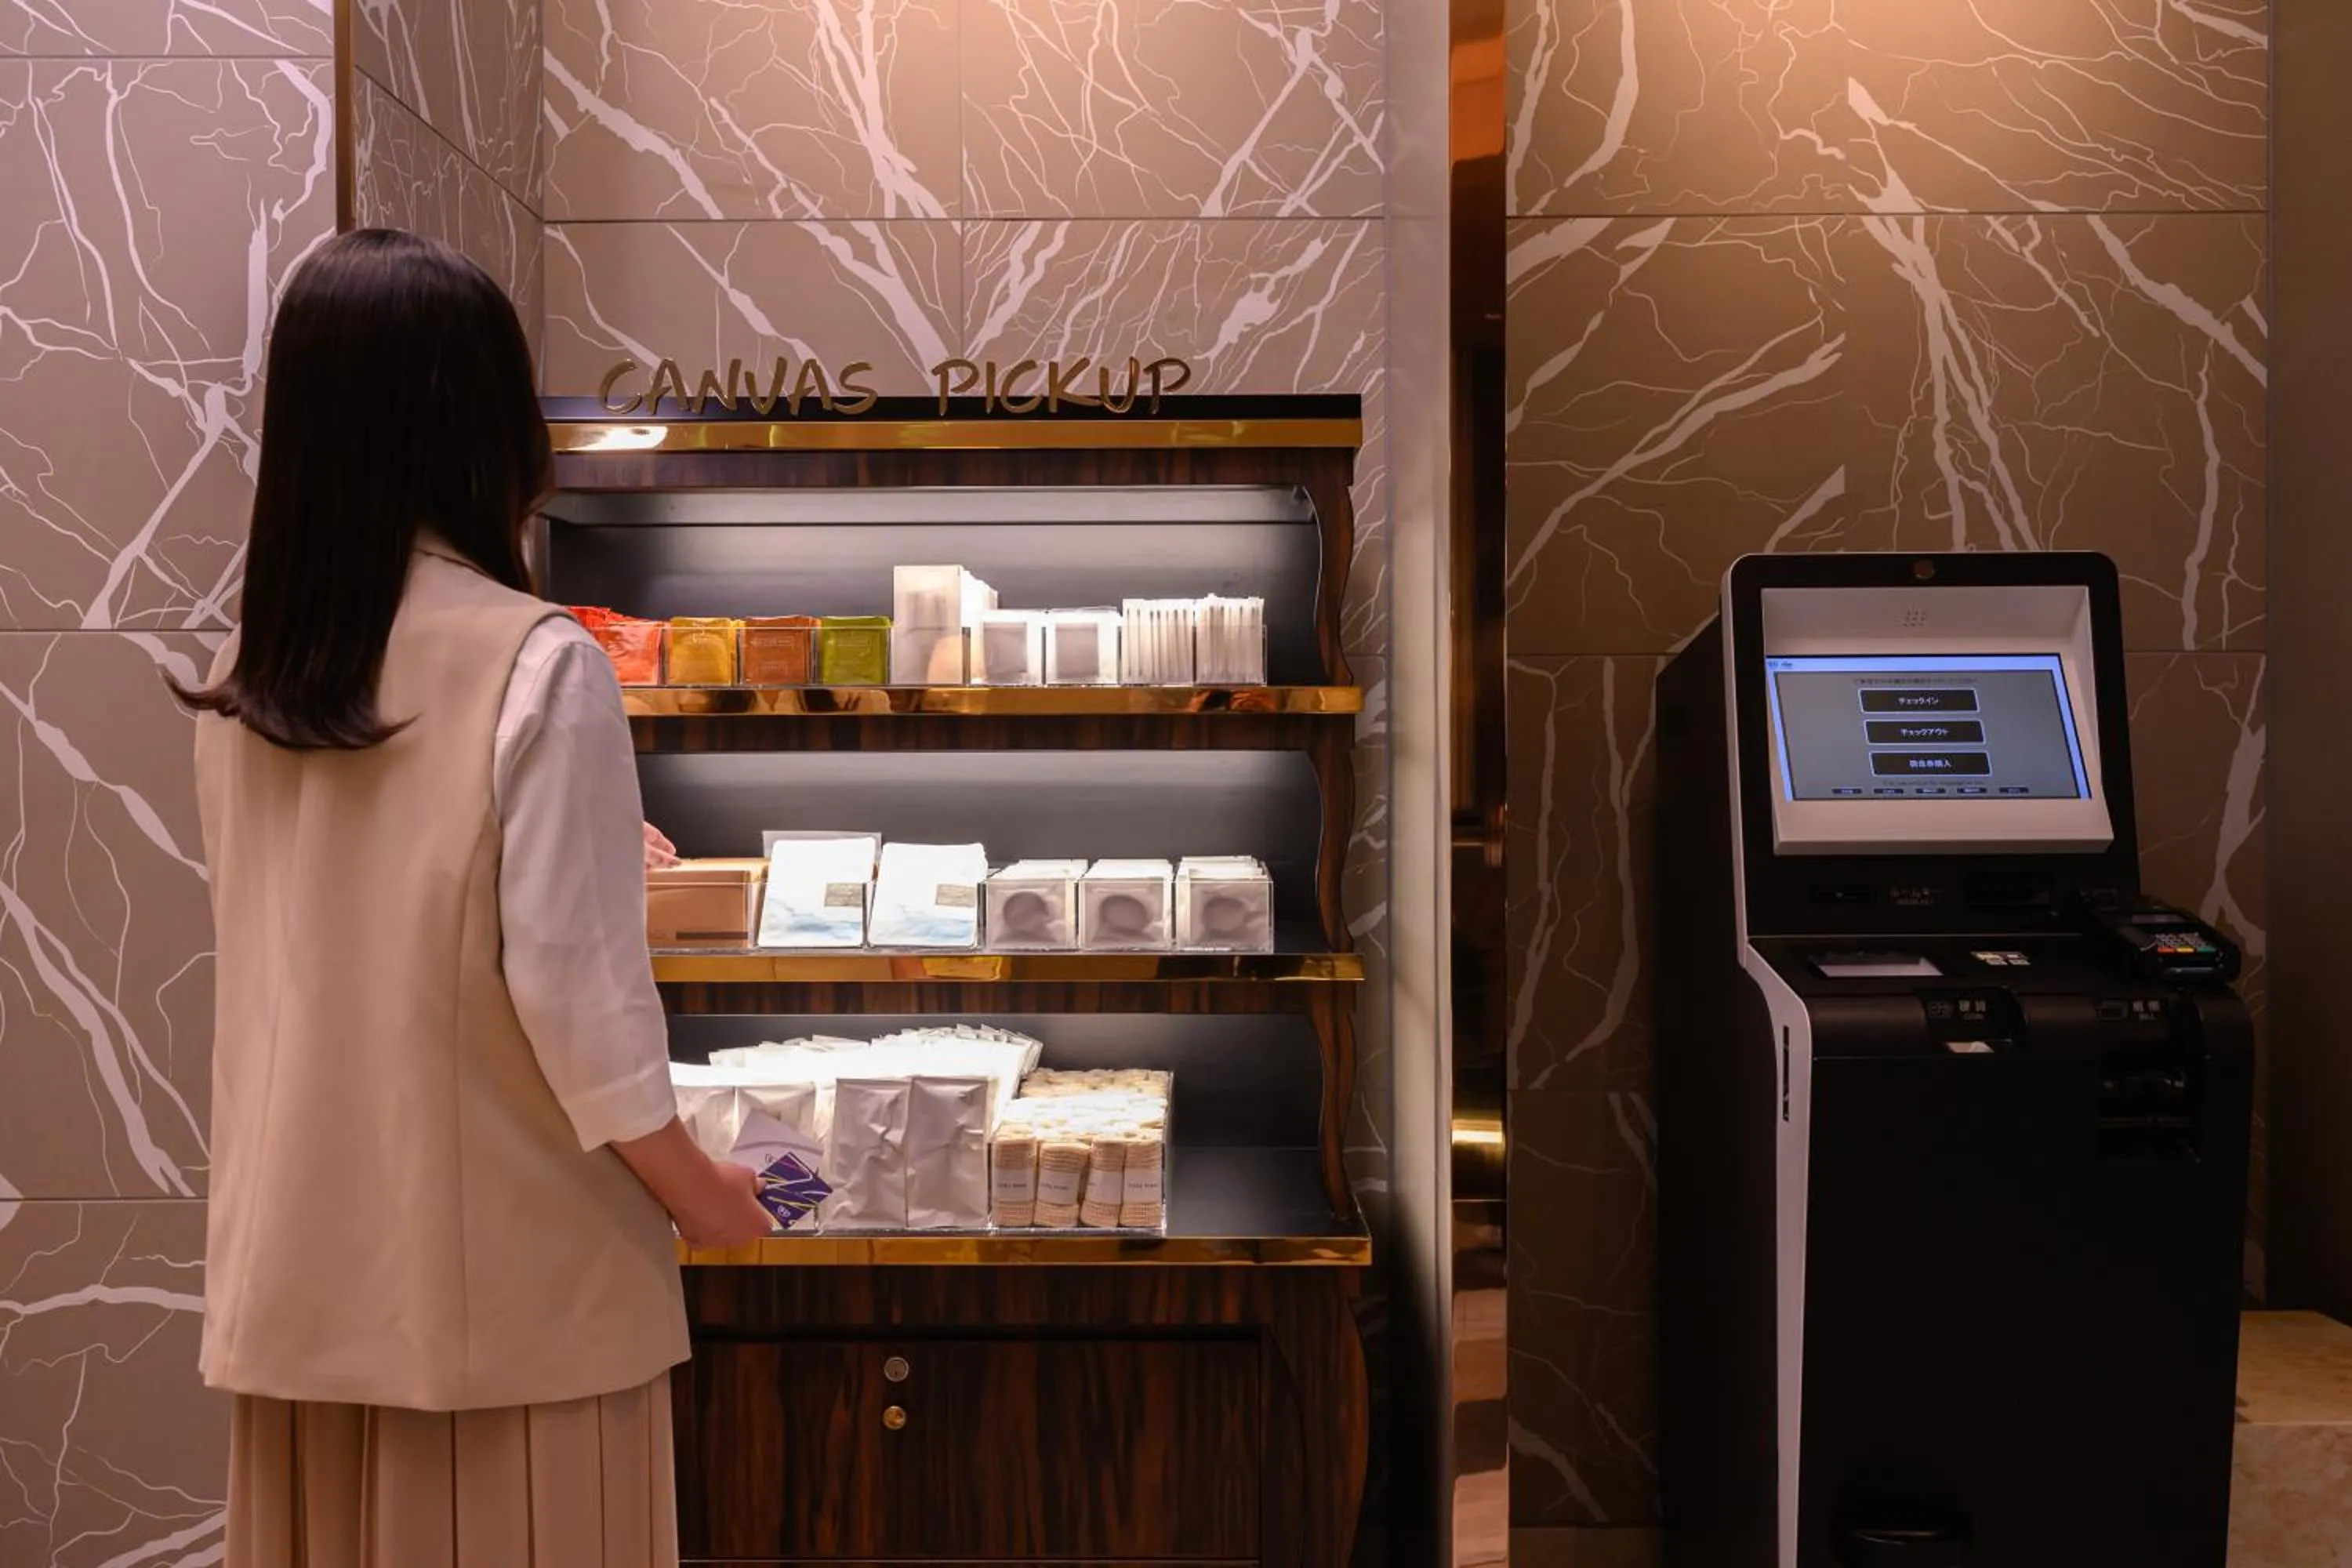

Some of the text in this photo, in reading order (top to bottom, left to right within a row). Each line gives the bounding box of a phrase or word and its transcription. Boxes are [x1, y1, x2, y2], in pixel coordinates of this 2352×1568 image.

[601, 358, 1191, 417] CANVAS PICKUP
[1898, 697, 1939, 706] チェックイン
